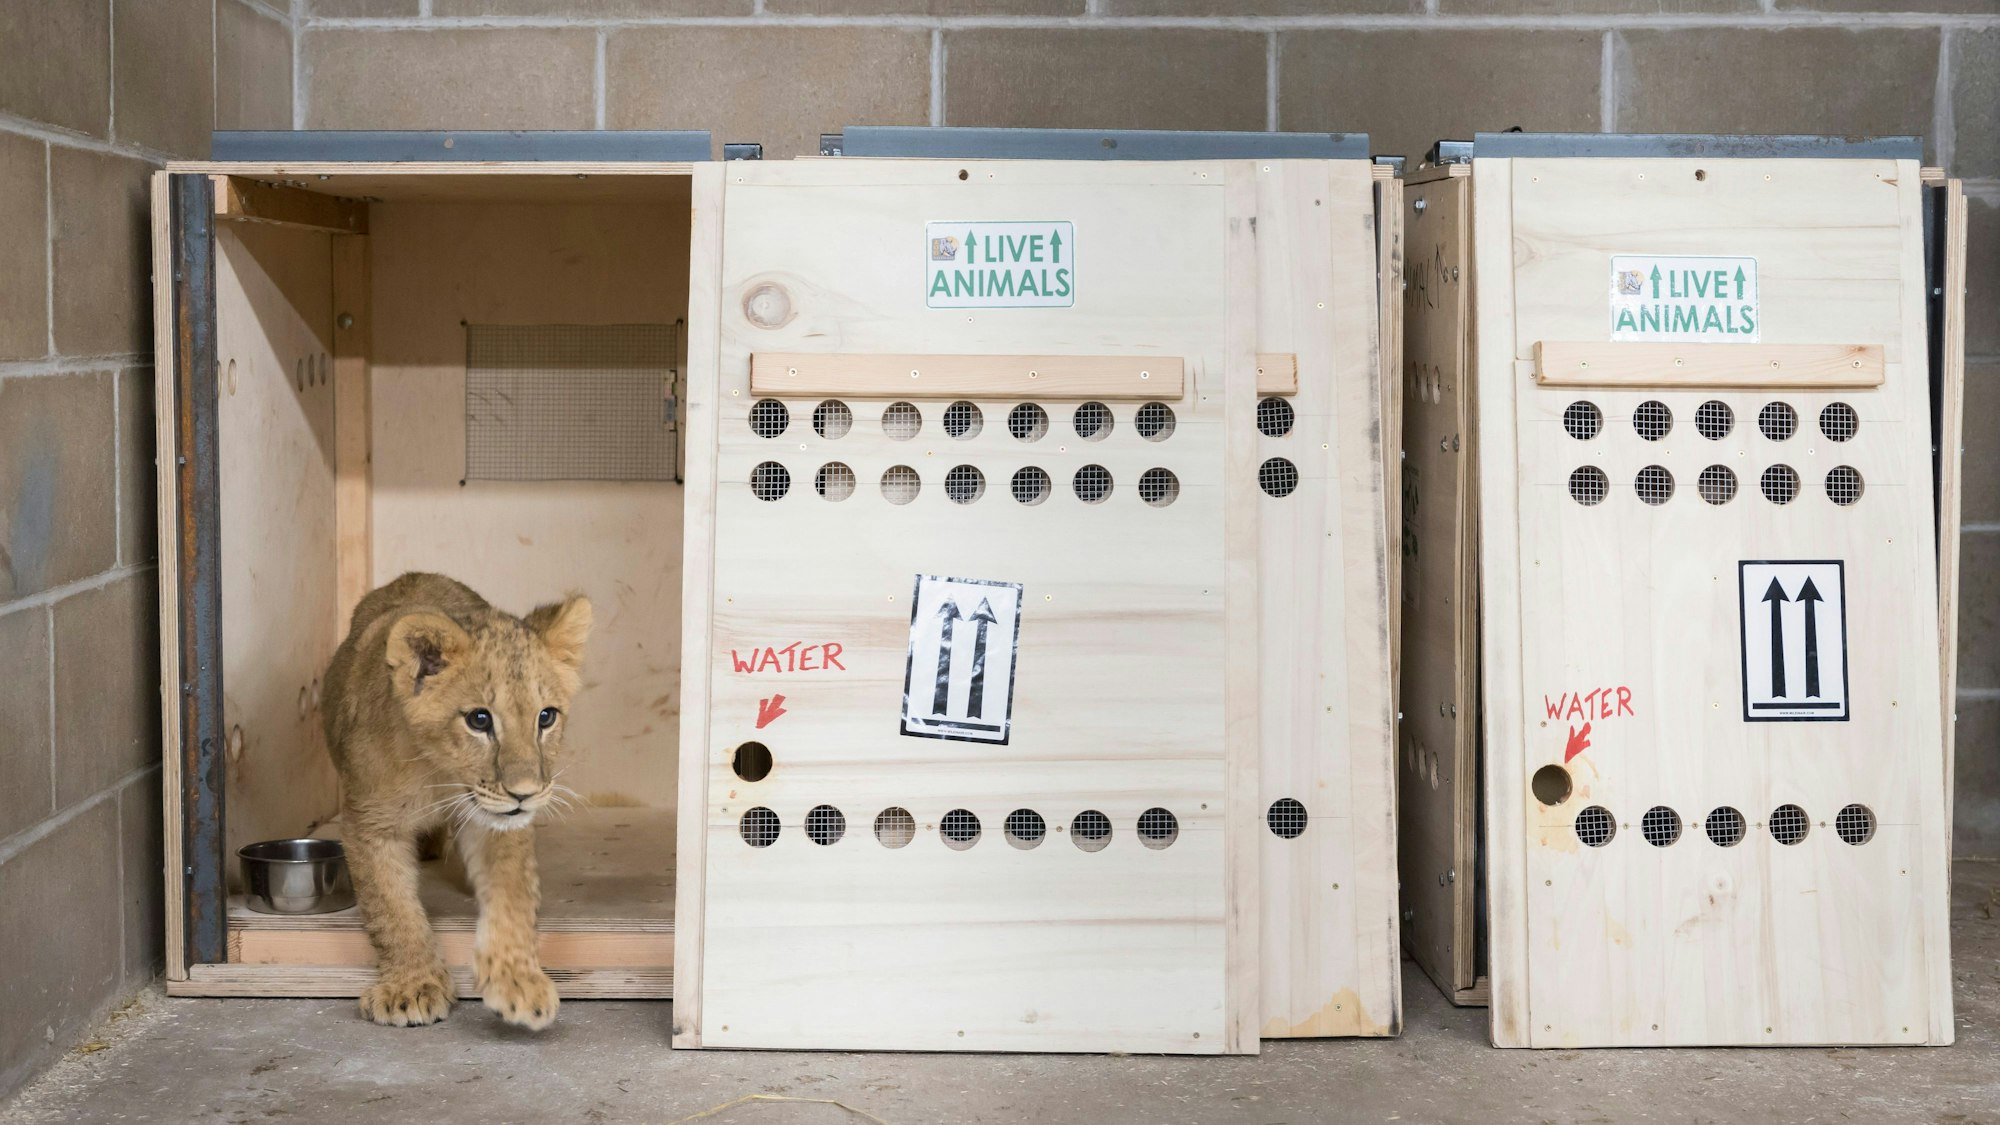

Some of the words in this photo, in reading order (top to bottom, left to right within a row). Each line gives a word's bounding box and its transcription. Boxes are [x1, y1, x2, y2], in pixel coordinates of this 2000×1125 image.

[985, 235, 1044, 263] LIVE
[929, 268, 1071, 298] ANIMALS
[1669, 270, 1728, 299] LIVE
[1615, 304, 1755, 334] ANIMALS
[731, 641, 846, 674] WATER
[1544, 686, 1634, 721] WATER
